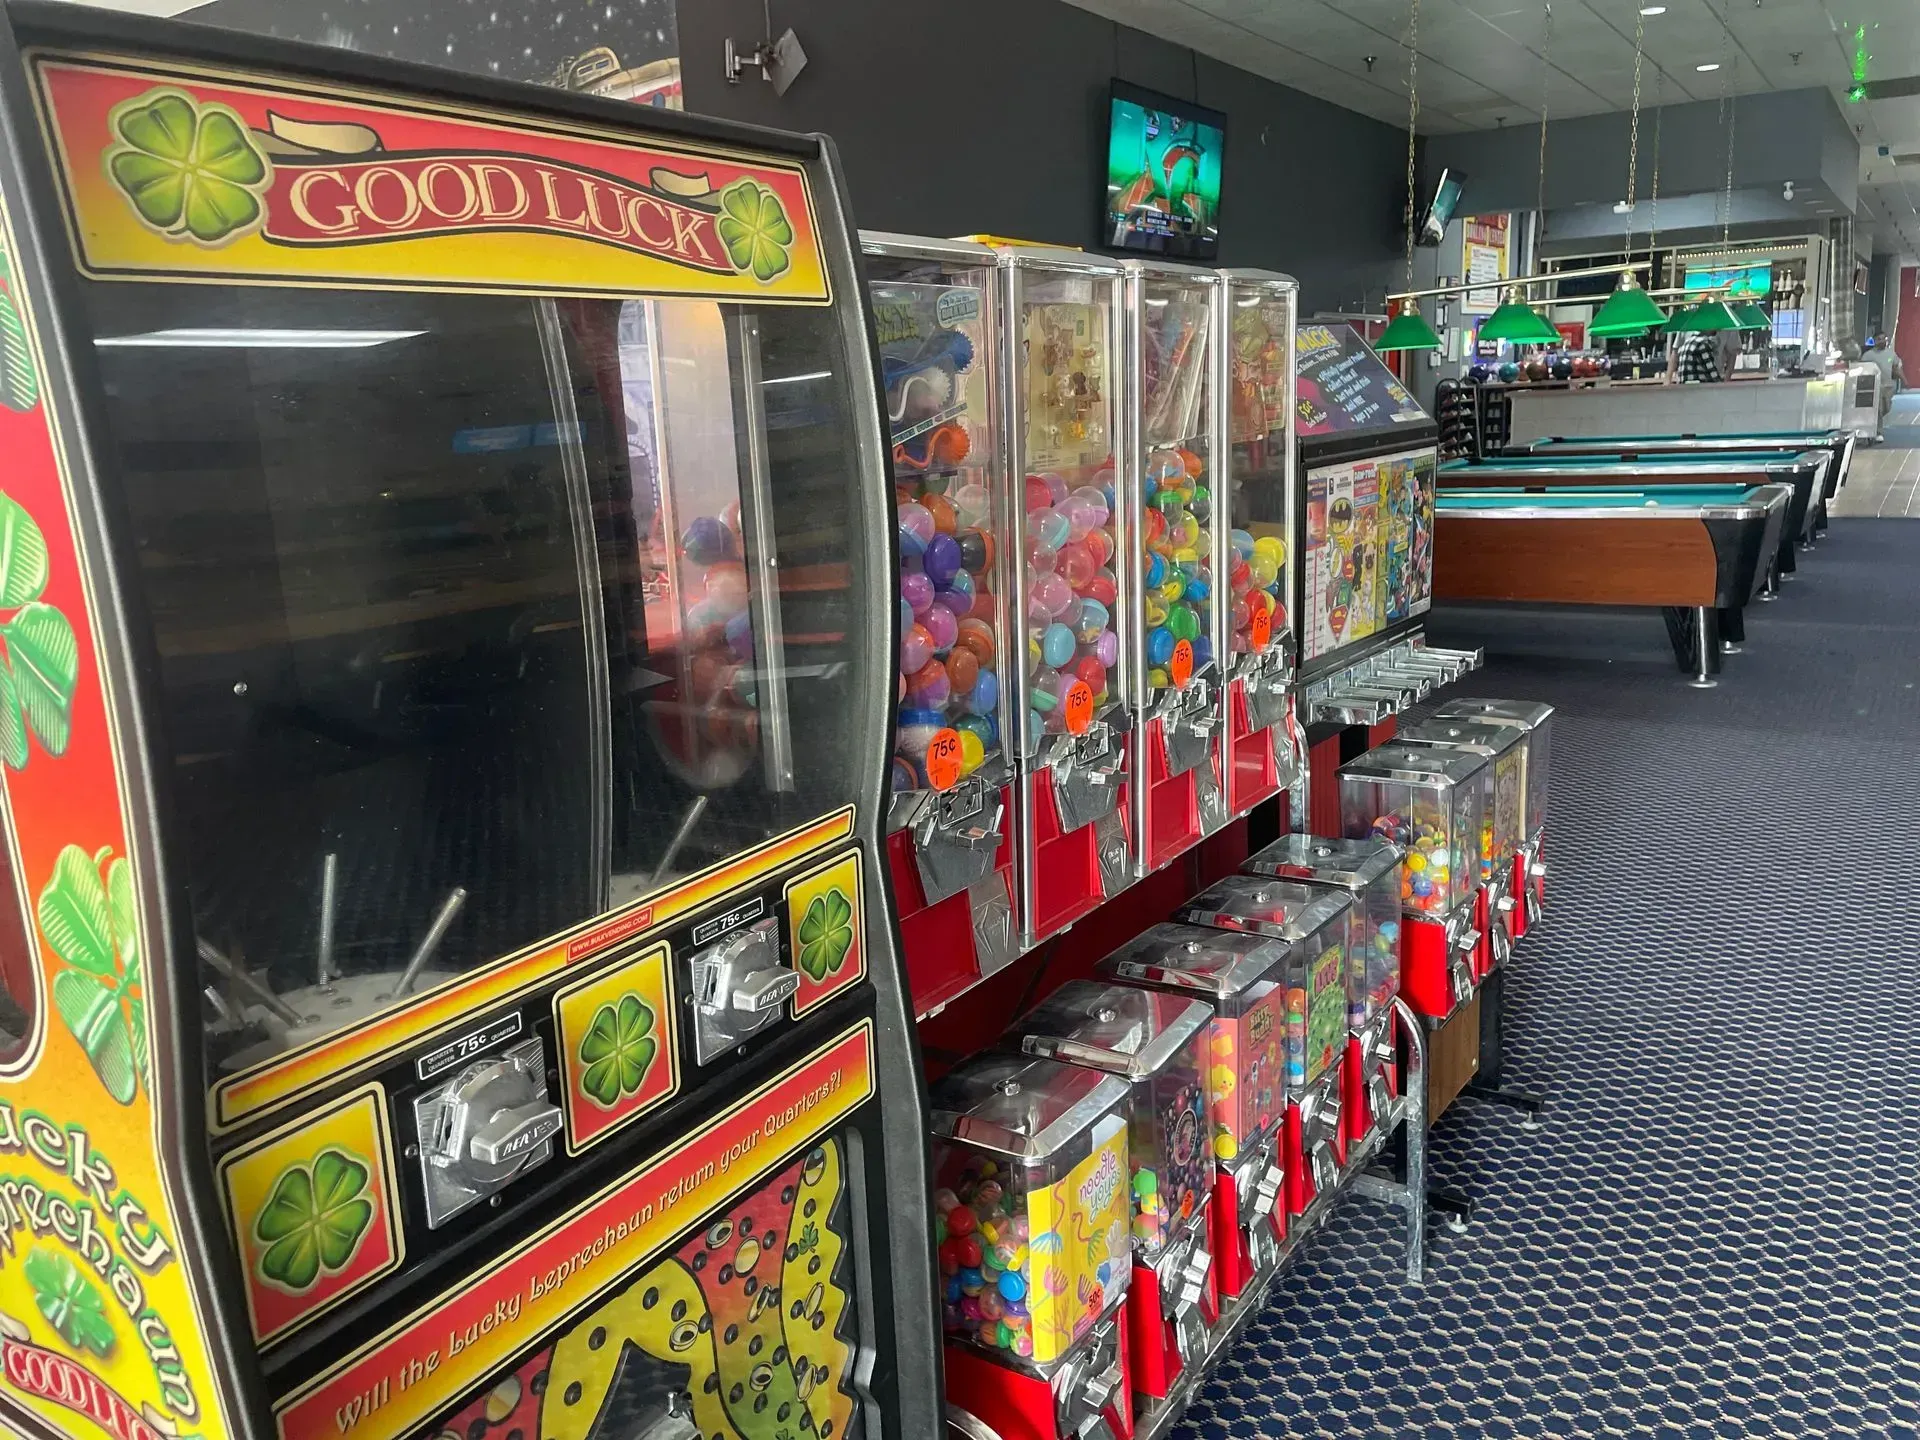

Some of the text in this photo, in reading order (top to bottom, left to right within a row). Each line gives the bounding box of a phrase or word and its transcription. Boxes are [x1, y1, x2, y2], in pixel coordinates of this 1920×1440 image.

[289, 162, 718, 265] GOOD LUCK
[1256, 616, 1267, 629] 75¢
[1176, 647, 1189, 663] 75¢
[1070, 690, 1087, 709] 75¢
[933, 738, 956, 760] 75¢
[720, 907, 760, 930] 75¢ QUARTER
[457, 1024, 516, 1056] 75¢ QUARTER
[427, 1046, 454, 1064] QUARTER
[428, 1055, 455, 1072] QUARTER
[0, 1106, 171, 1268] ucky
[1079, 1149, 1116, 1202] noodle
[1090, 1168, 1121, 1223] yoyos
[336, 1376, 390, 1434] Will
[399, 1349, 442, 1392] the
[447, 1292, 522, 1358] Lucky
[529, 1203, 653, 1303] Leprechaun
[658, 1158, 716, 1214] return
[720, 1130, 760, 1174] your
[8, 1345, 87, 1408] GOOD
